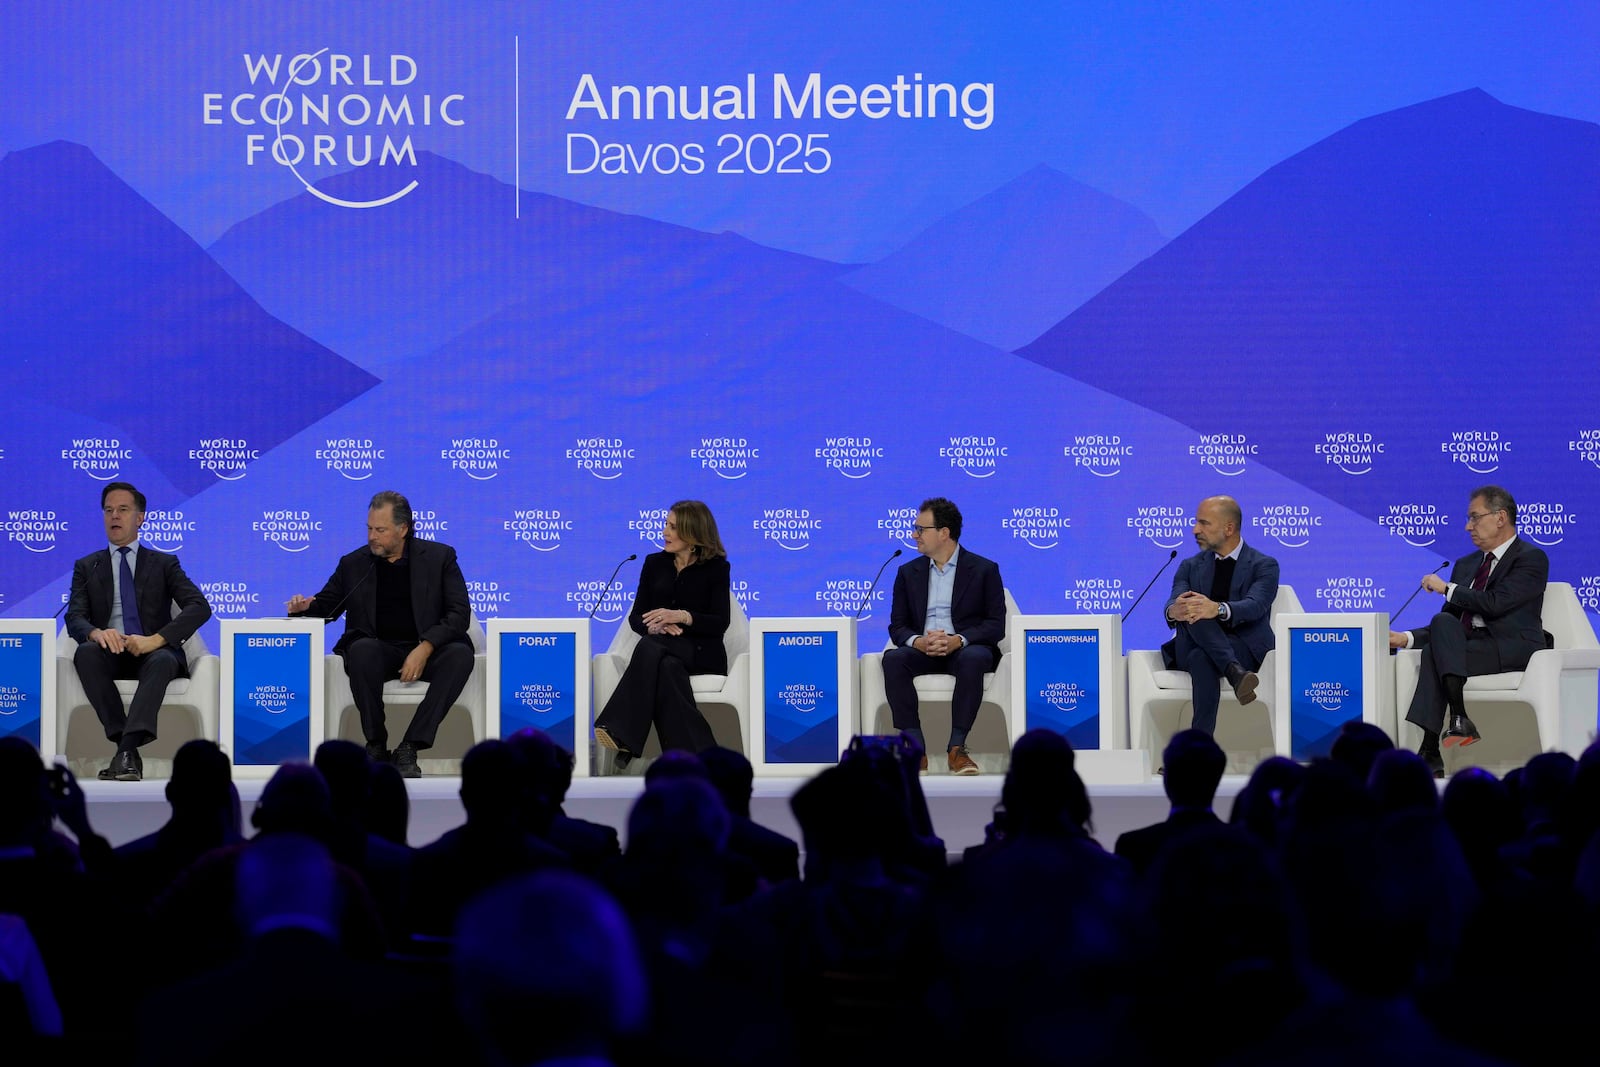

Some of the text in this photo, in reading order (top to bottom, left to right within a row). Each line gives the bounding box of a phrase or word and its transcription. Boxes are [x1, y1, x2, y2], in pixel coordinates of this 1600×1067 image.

[243, 54, 417, 86] WORLD
[565, 73, 995, 131] Annual Meeting
[203, 93, 465, 126] ECONOMIC
[246, 134, 418, 166] FORUM
[566, 133, 832, 175] Davos 2025
[1075, 436, 1120, 445] WORLD
[1200, 435, 1245, 444] WORLD
[1326, 433, 1371, 442] WORLD
[1453, 432, 1498, 441] WORLD
[73, 440, 119, 449] WORLD
[200, 440, 246, 449] WORLD
[327, 440, 372, 449] WORLD
[452, 439, 497, 448] WORLD
[577, 439, 622, 448] WORLD
[702, 439, 747, 448] WORLD
[826, 438, 871, 447] WORLD
[950, 437, 995, 446] WORLD
[1065, 446, 1132, 455] ECONOMIC
[1190, 445, 1257, 454] ECONOMIC
[1315, 444, 1384, 453] ECONOMIC
[1442, 442, 1511, 451] ECONOMIC
[62, 450, 131, 459] ECONOMIC
[189, 450, 258, 459] ECONOMIC
[316, 450, 384, 459] ECONOMIC
[442, 450, 509, 459] ECONOMIC
[567, 449, 634, 458] ECONOMIC
[691, 449, 758, 458] ECONOMIC
[816, 448, 883, 457] ECONOMIC
[940, 447, 1007, 456] ECONOMIC
[1076, 457, 1120, 466] FORUM
[1201, 455, 1245, 464] FORUM
[1327, 454, 1371, 463] FORUM
[1453, 453, 1498, 462] FORUM
[73, 461, 119, 470] FORUM
[201, 461, 246, 470] FORUM
[327, 460, 372, 469] FORUM
[453, 460, 497, 469] FORUM
[578, 459, 622, 468] FORUM
[702, 459, 746, 468] FORUM
[827, 458, 871, 467] FORUM
[951, 458, 995, 467] FORUM
[1013, 508, 1058, 517] WORLD
[1138, 507, 1183, 516] WORLD
[1264, 506, 1309, 515] WORLD
[1390, 505, 1435, 514] WORLD
[1517, 504, 1563, 513] WORLD
[9, 511, 55, 520] WORLD
[144, 512, 183, 521] ORLD
[264, 511, 309, 520] WORLD
[412, 511, 435, 520] RLD
[515, 511, 560, 520] WORLD
[640, 510, 668, 519] WOR
[764, 510, 809, 519] WORLD
[889, 509, 917, 518] WOR
[754, 520, 821, 529] ECONOMIC
[878, 520, 916, 529] ECON
[1003, 518, 1070, 527] ECONOMIC
[1128, 518, 1196, 527] ECONOMIC
[1253, 517, 1321, 526] ECONOMIC
[1379, 516, 1448, 525] ECONOMIC
[141, 522, 195, 531] ONOMIC
[253, 522, 321, 531] ECONOMIC
[414, 521, 447, 530] OMIC
[504, 521, 572, 530] ECONOMIC
[629, 521, 666, 530] ECON
[1518, 525, 1563, 534] FORUM
[765, 530, 809, 539] FORUM
[889, 530, 912, 539] FOR
[1014, 529, 1058, 538] FORUM
[1139, 528, 1183, 537] FORUM
[1264, 527, 1309, 536] FORUM
[1390, 526, 1435, 535] FORUM
[9, 532, 55, 541] FORUM
[264, 532, 309, 541] FORUM
[515, 531, 560, 540] FORUM
[640, 531, 664, 540] FOR
[466, 582, 498, 591] ORLD
[578, 582, 622, 591] WORLD
[827, 581, 872, 590] WORLD
[1076, 580, 1121, 589] WORLD
[1327, 578, 1372, 587] WORLD
[201, 583, 246, 592] WORLD
[468, 593, 510, 602] NOMIC
[567, 592, 634, 601] ECONOMIC
[816, 591, 884, 600] ECONOMIC
[1065, 590, 1133, 599] ECONOMIC
[1317, 589, 1385, 598] ECONOMIC
[204, 594, 258, 603] ONOMIC
[470, 603, 497, 612] RUM
[578, 602, 622, 611] FORUM
[827, 601, 871, 610] FORUM
[1077, 601, 1121, 610] FORUM
[1328, 599, 1372, 608] FORUM
[210, 604, 246, 613] ORUM
[248, 638, 296, 646] BENIOFF
[519, 637, 557, 646] PORAT
[779, 637, 822, 645] AMODEI
[1305, 633, 1349, 642] BOURLA
[2, 639, 22, 647] TTE
